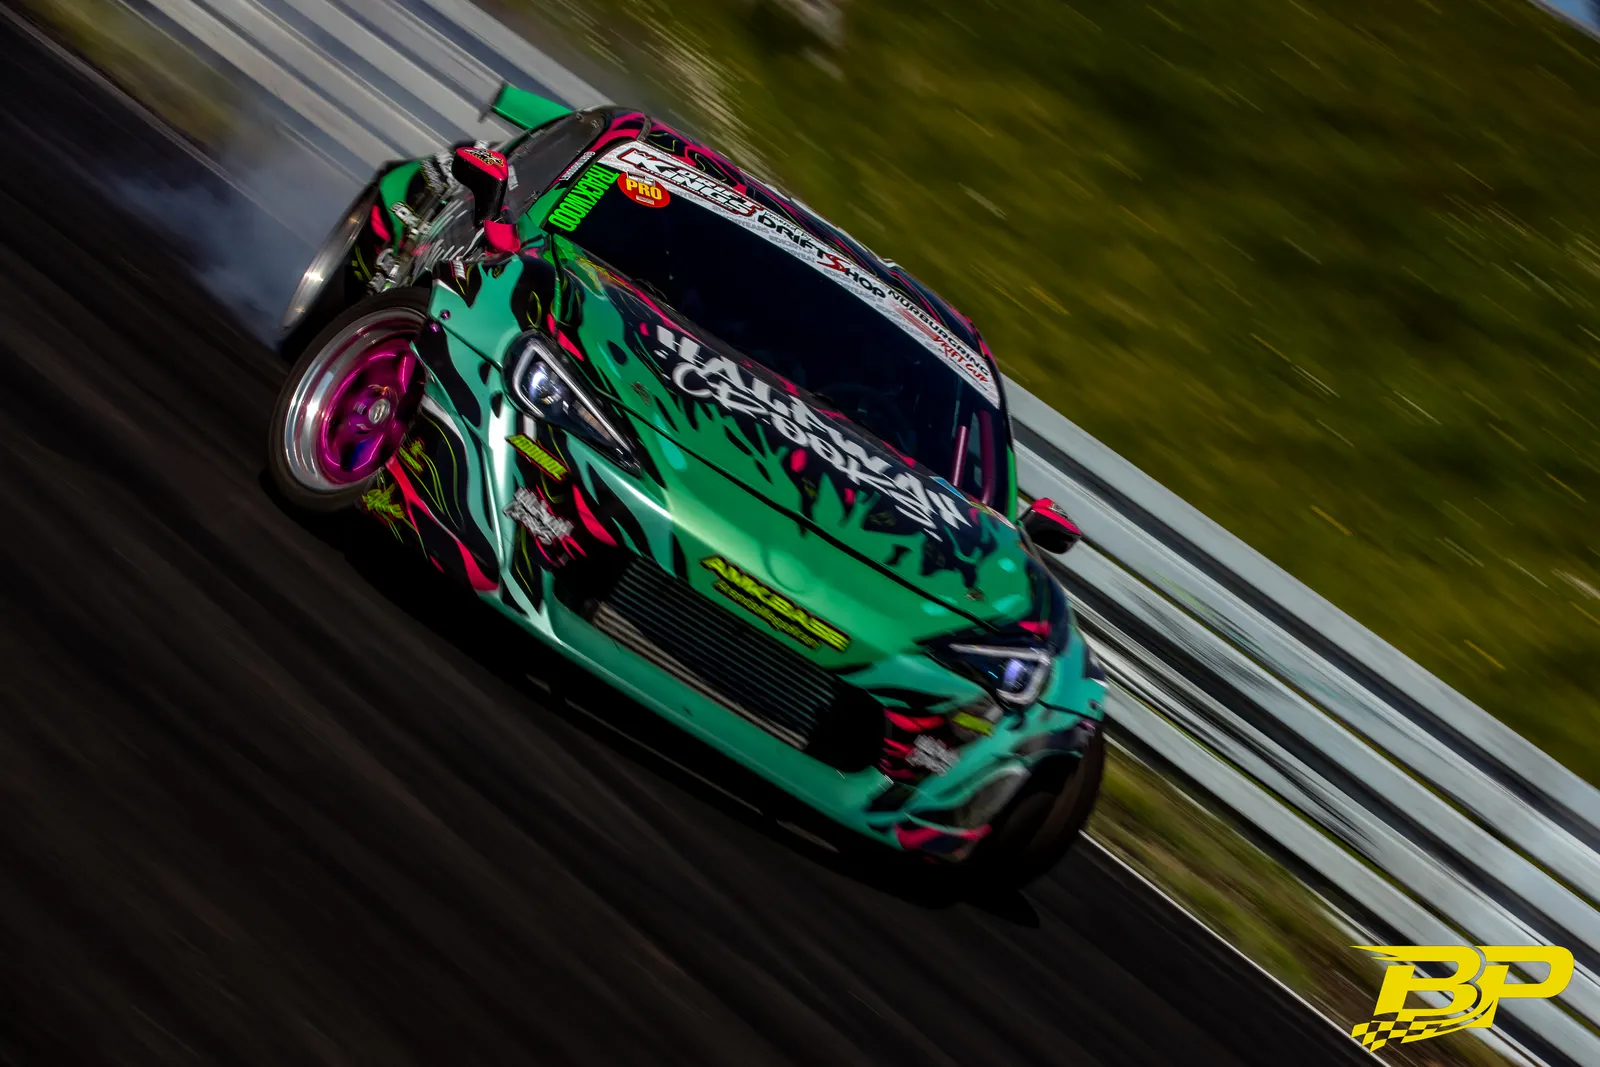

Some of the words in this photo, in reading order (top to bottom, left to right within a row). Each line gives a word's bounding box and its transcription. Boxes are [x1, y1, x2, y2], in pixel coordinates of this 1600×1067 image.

[548, 163, 620, 232] TRACKWOOD
[625, 177, 663, 201] PRO
[678, 167, 757, 210] DRIFT
[656, 325, 973, 530] HALFWAY
[672, 361, 939, 531] CROOKS
